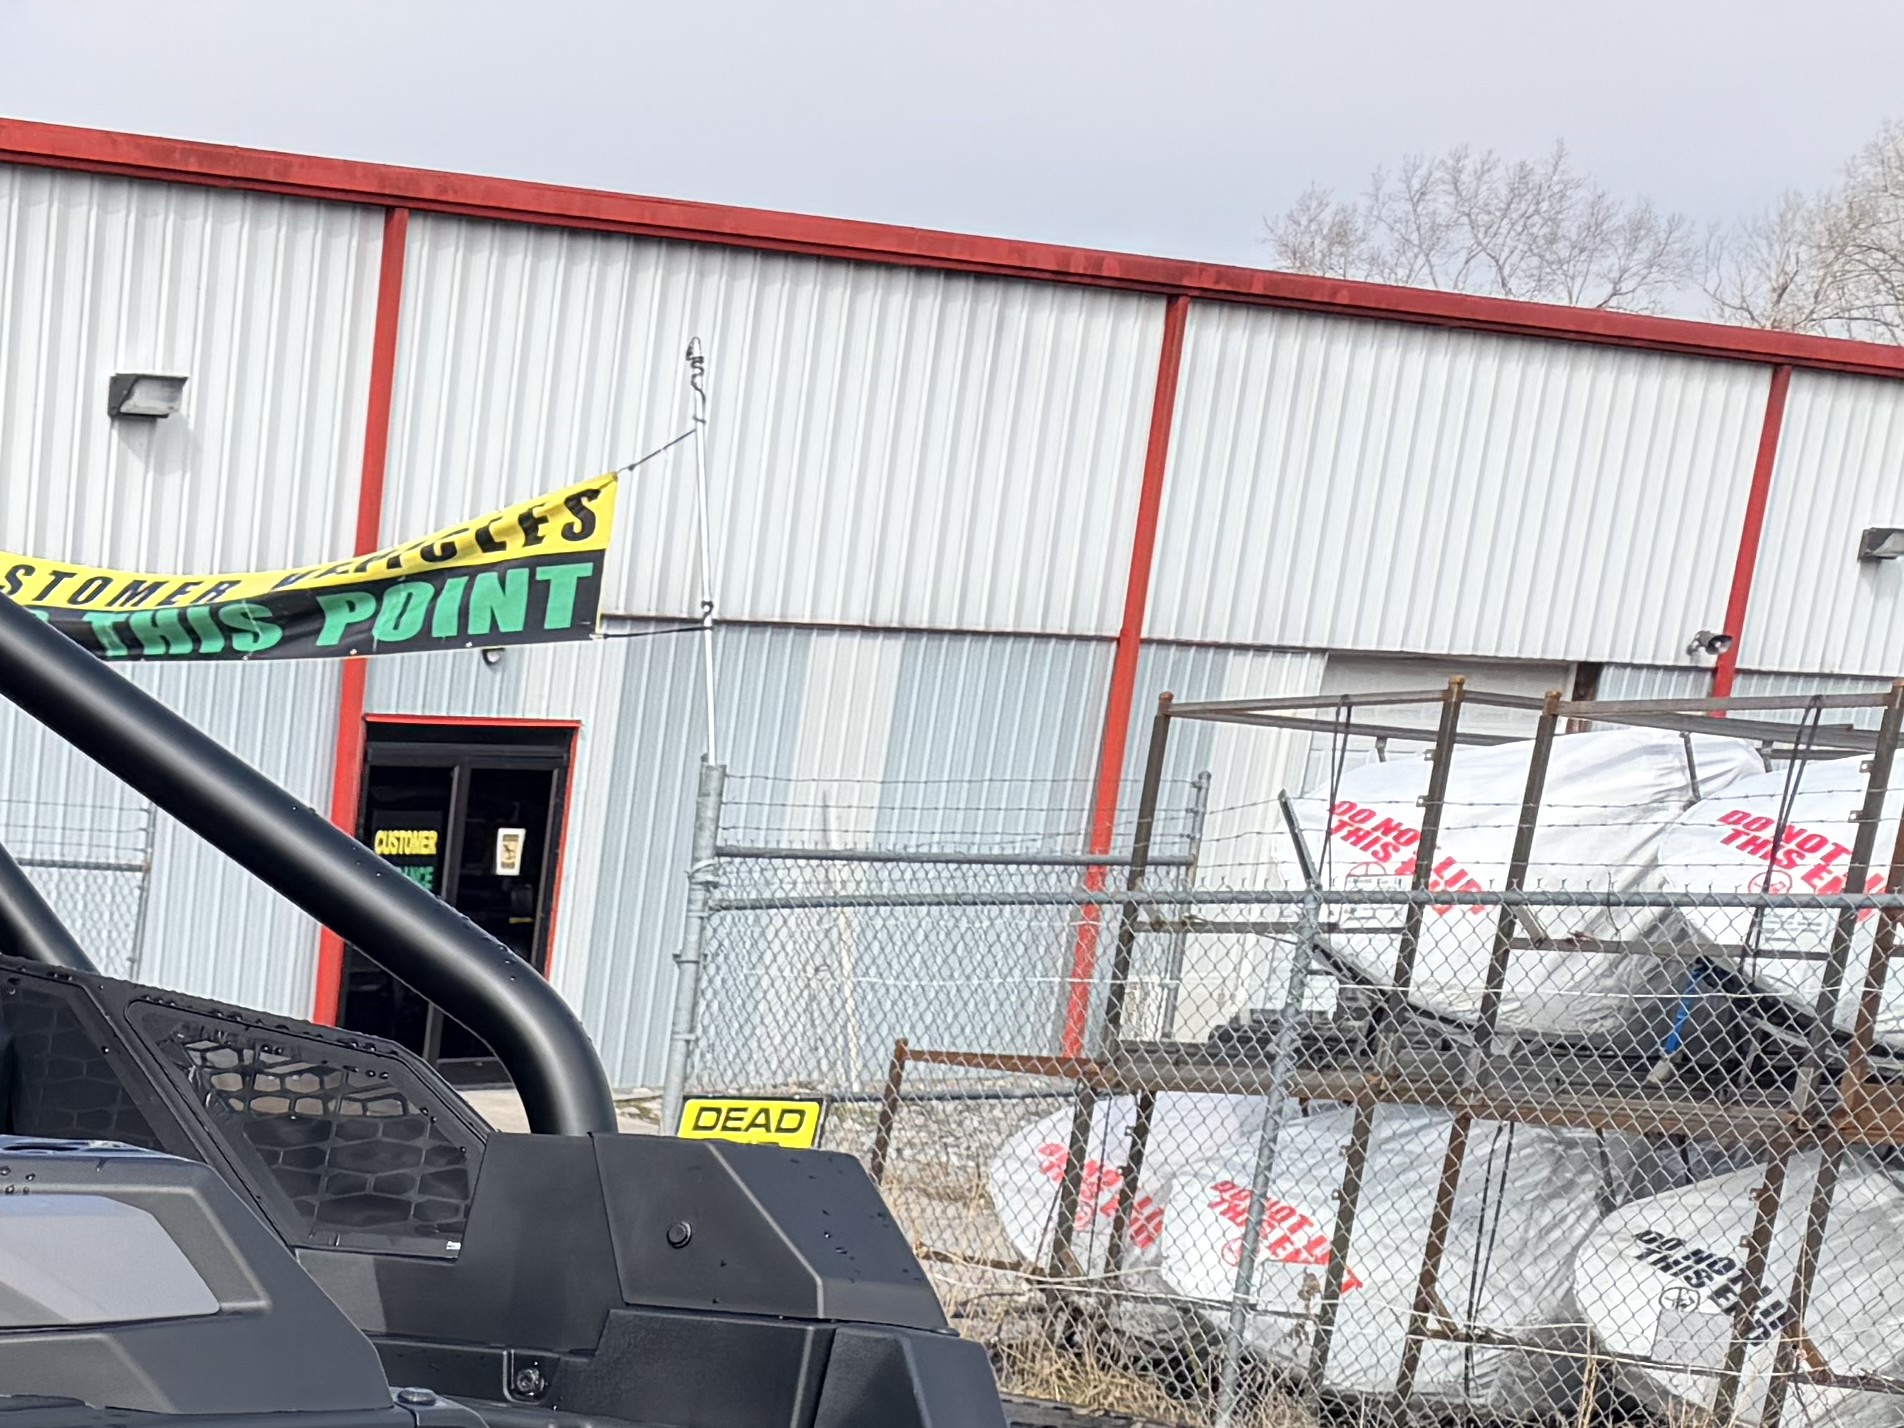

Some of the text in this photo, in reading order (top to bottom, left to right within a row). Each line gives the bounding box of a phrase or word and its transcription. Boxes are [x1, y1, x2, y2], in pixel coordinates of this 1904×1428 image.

[82, 603, 283, 657] THIS
[315, 562, 594, 647] POINT
[1371, 817, 1422, 847] NO
[1717, 809, 1775, 833] DO
[374, 829, 438, 855] CUSTOMER
[1330, 819, 1401, 863] THIS
[692, 1106, 806, 1134] DEAD
